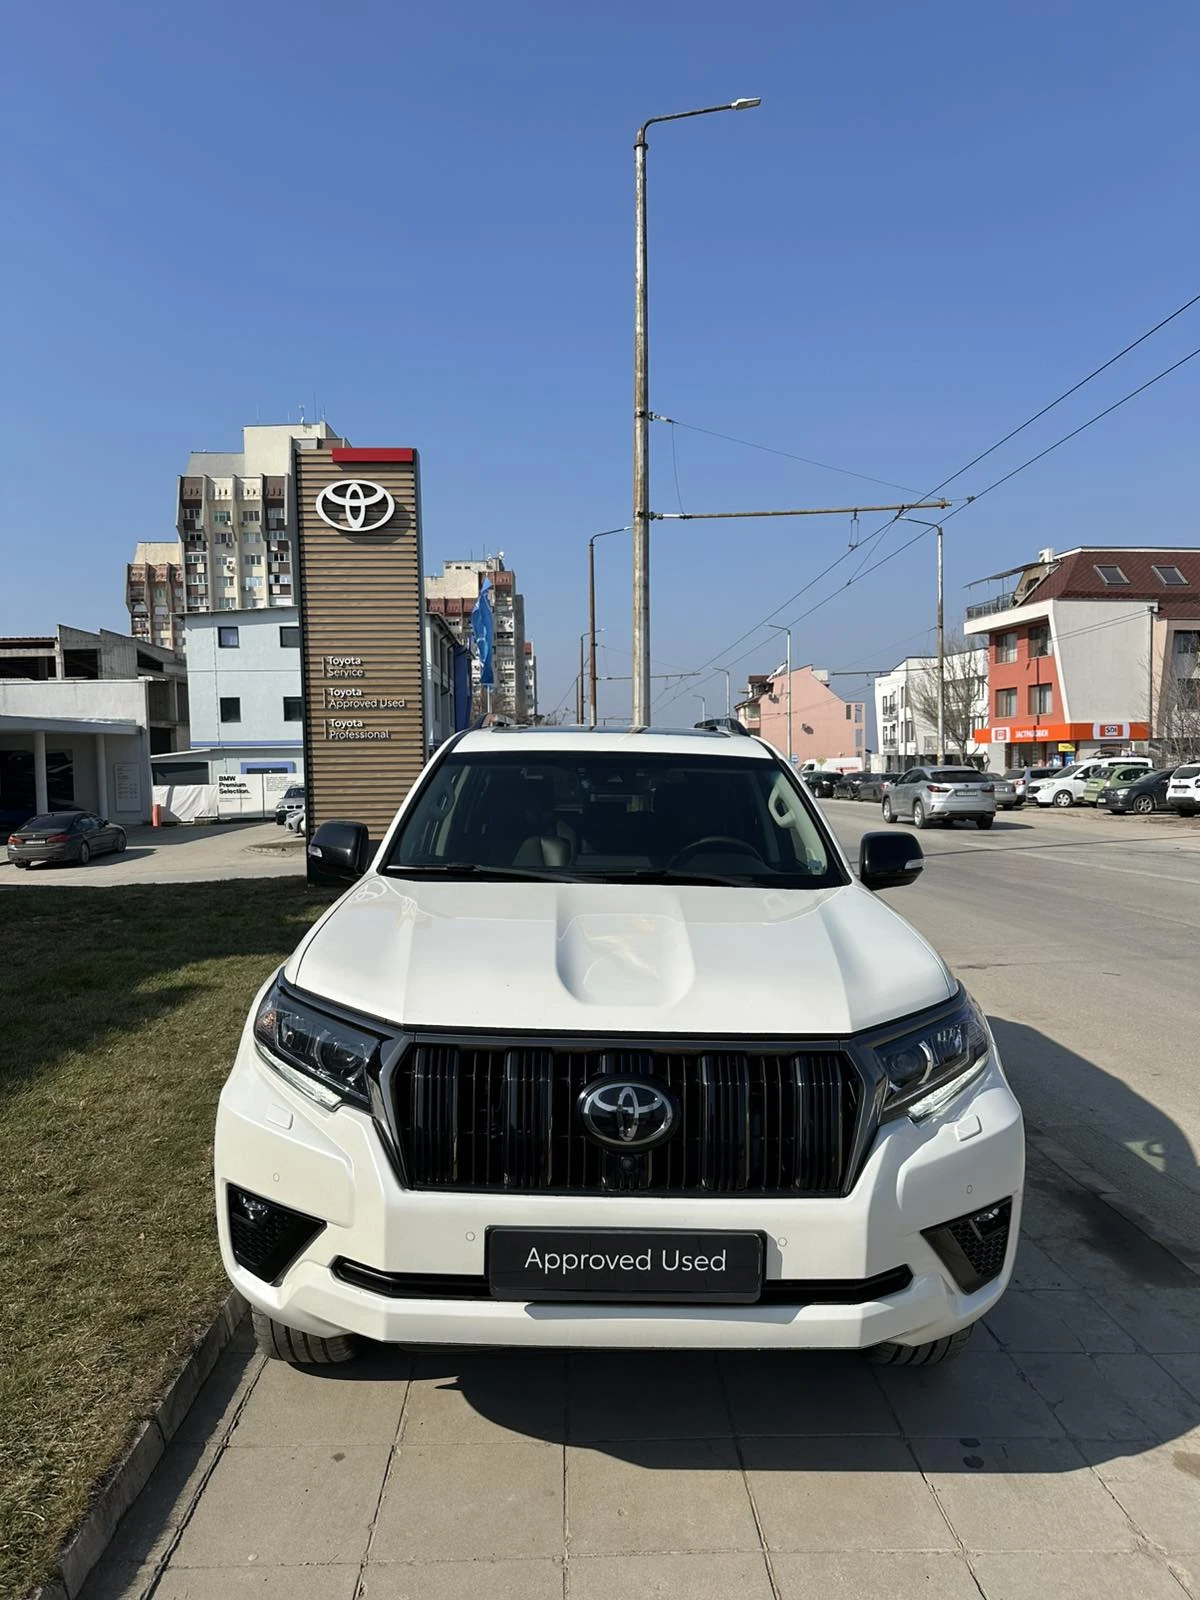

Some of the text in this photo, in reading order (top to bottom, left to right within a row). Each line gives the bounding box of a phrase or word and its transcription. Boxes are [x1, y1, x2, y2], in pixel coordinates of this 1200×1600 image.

[328, 656, 361, 666] Toyota
[328, 668, 363, 676] Service
[329, 688, 362, 698] Toyota
[329, 699, 405, 709] Approved Used
[330, 719, 363, 728] Toyota
[330, 729, 389, 739] Professional
[525, 1247, 726, 1275] Approved Used
